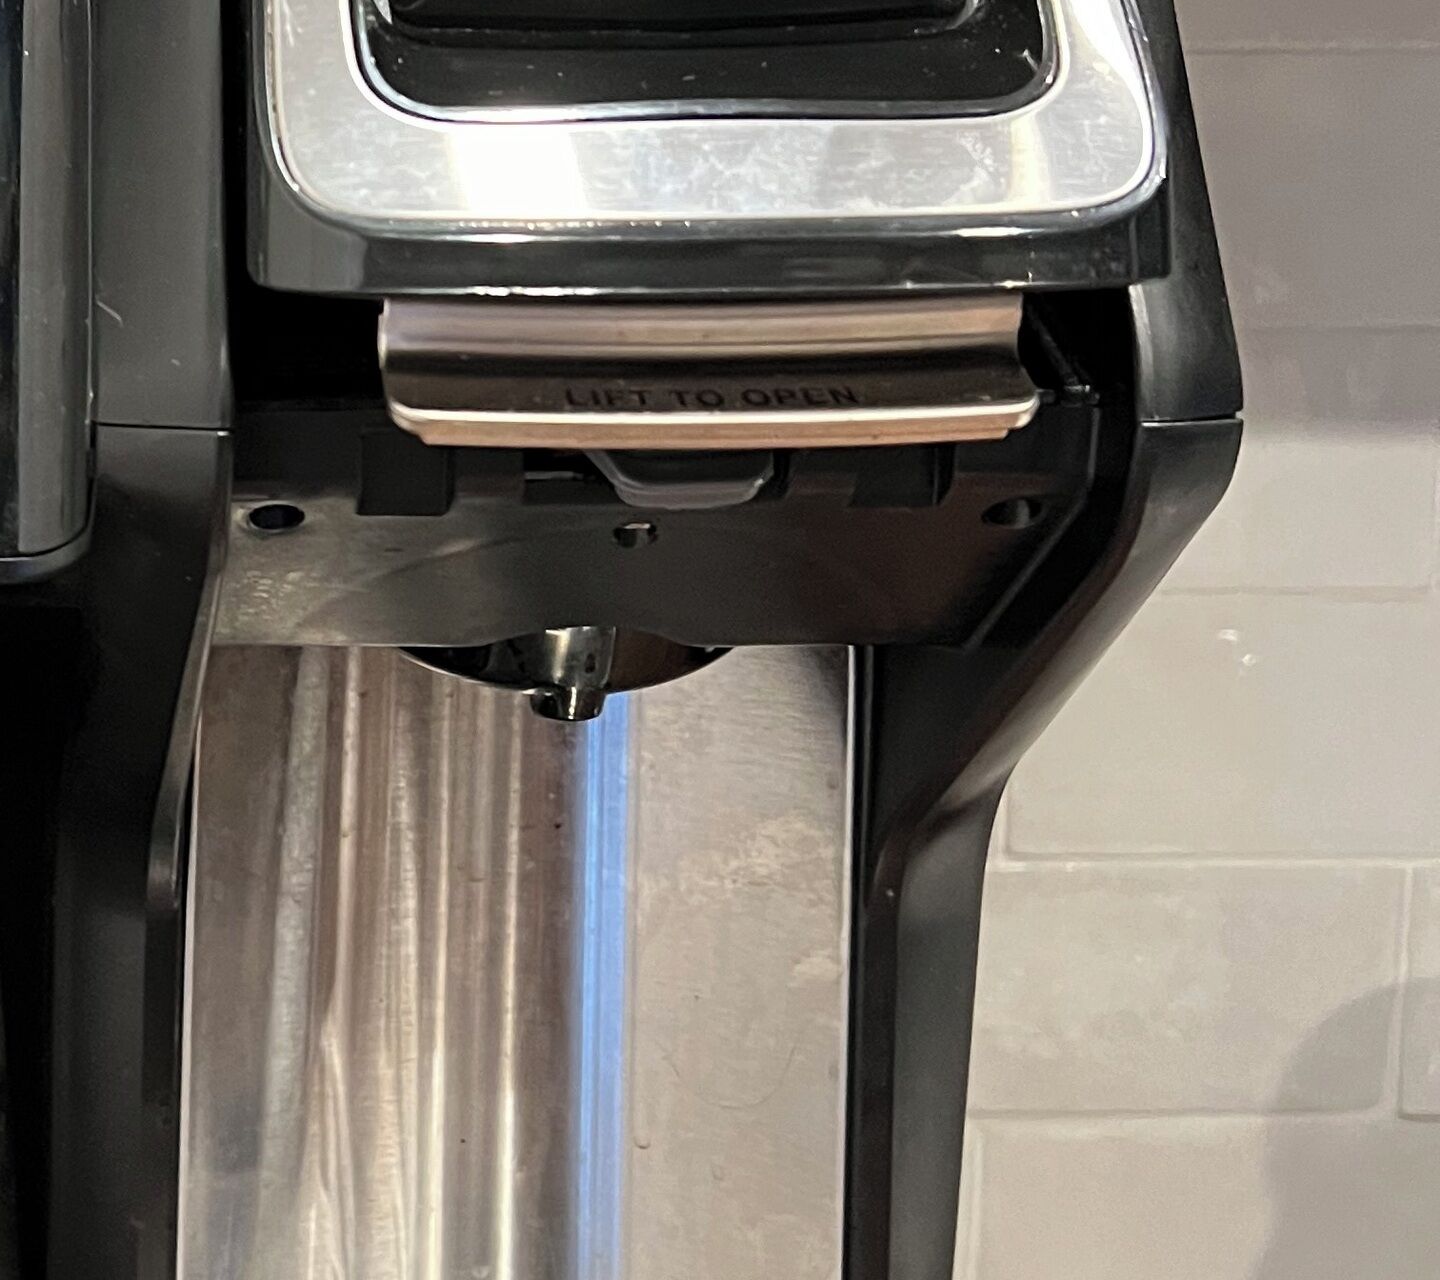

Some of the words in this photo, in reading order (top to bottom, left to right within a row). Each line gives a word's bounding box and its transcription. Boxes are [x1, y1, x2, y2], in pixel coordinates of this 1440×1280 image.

[565, 389, 652, 406] LIFT
[670, 388, 725, 407] TO
[740, 386, 859, 407] OPEN
